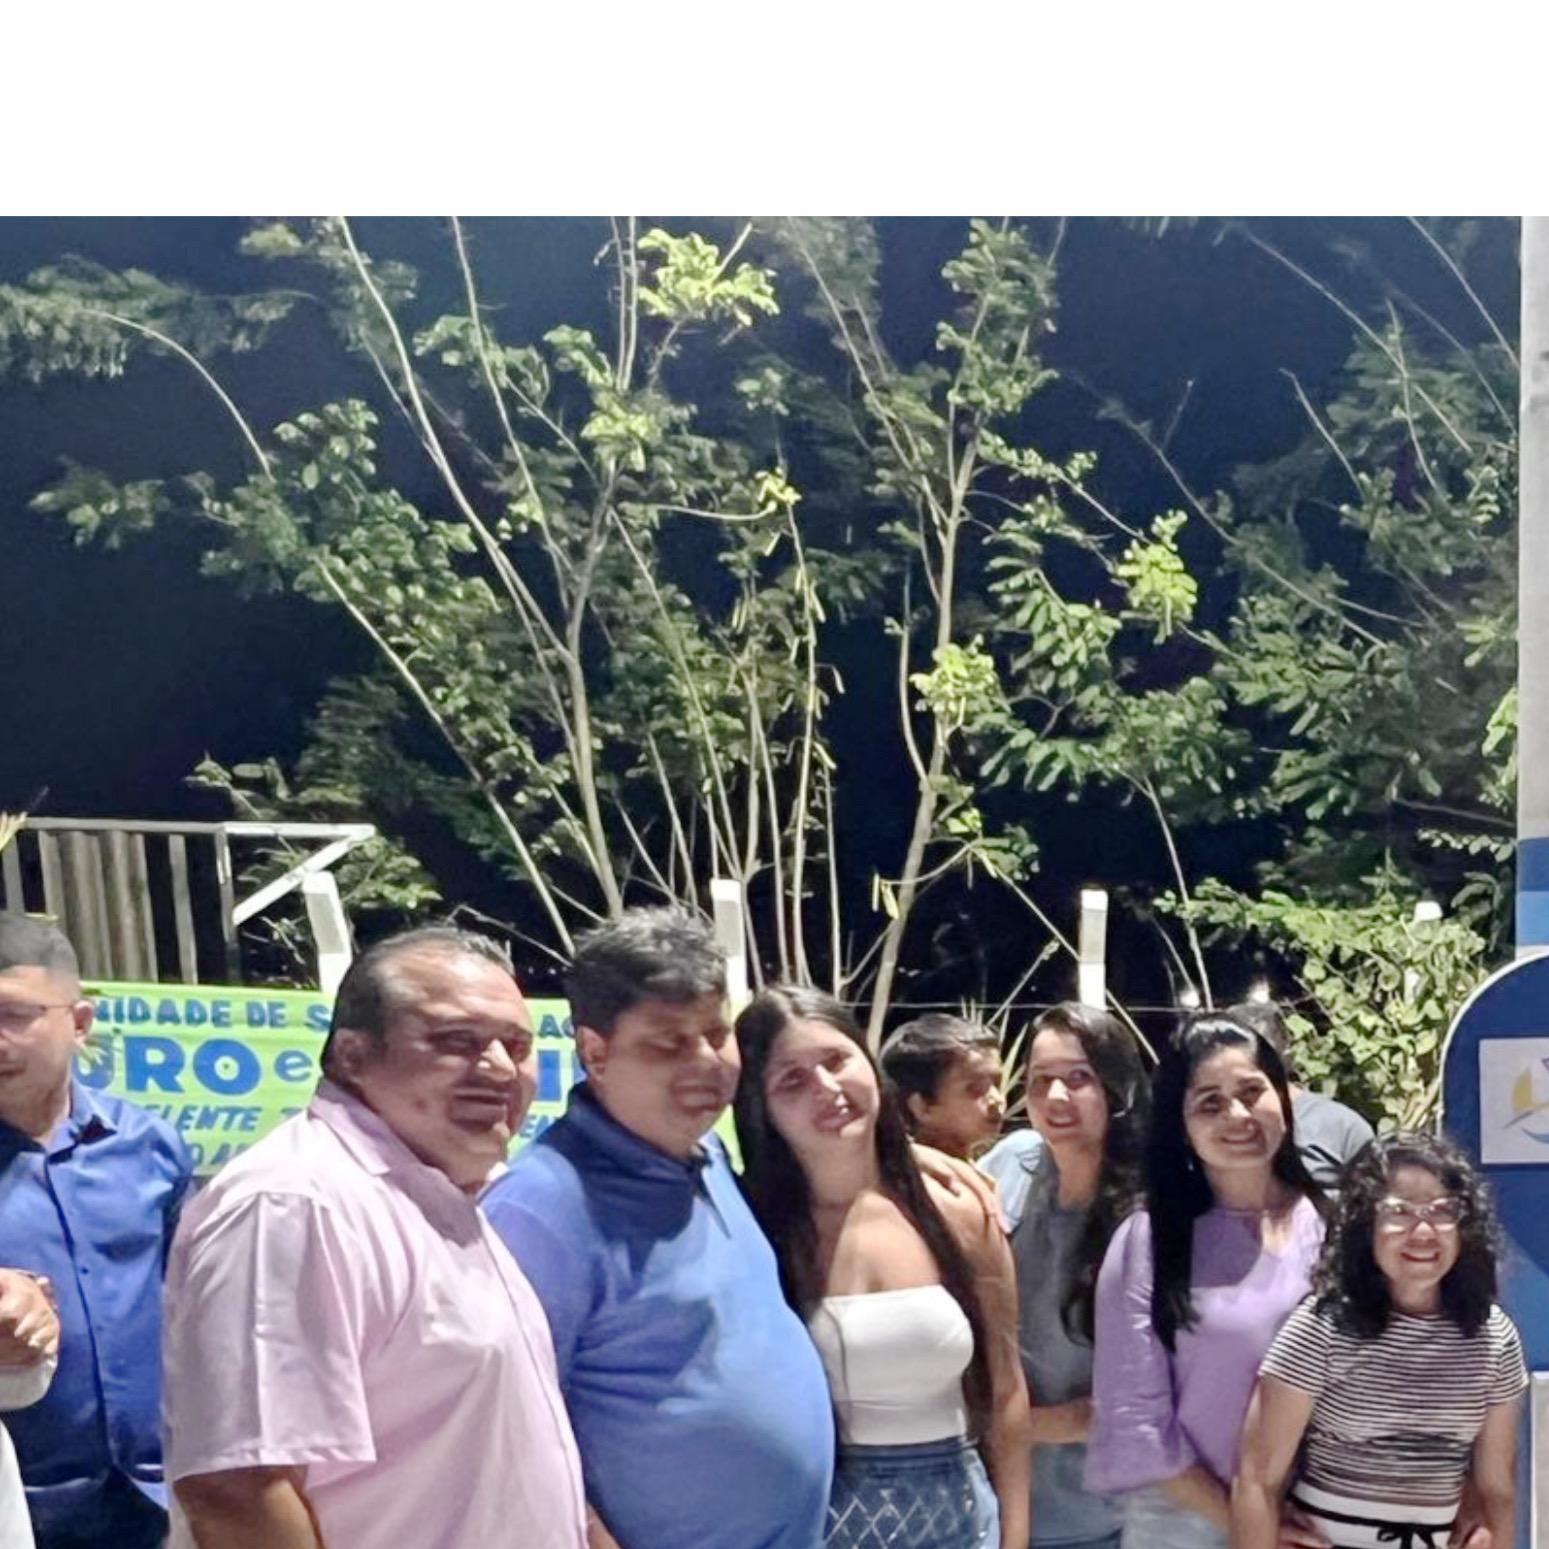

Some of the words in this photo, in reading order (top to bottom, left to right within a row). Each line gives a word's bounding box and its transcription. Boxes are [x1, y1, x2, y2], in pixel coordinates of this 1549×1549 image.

[95, 997, 231, 1028] NIDADE
[246, 1001, 287, 1029] DE
[273, 1050, 313, 1083] e
